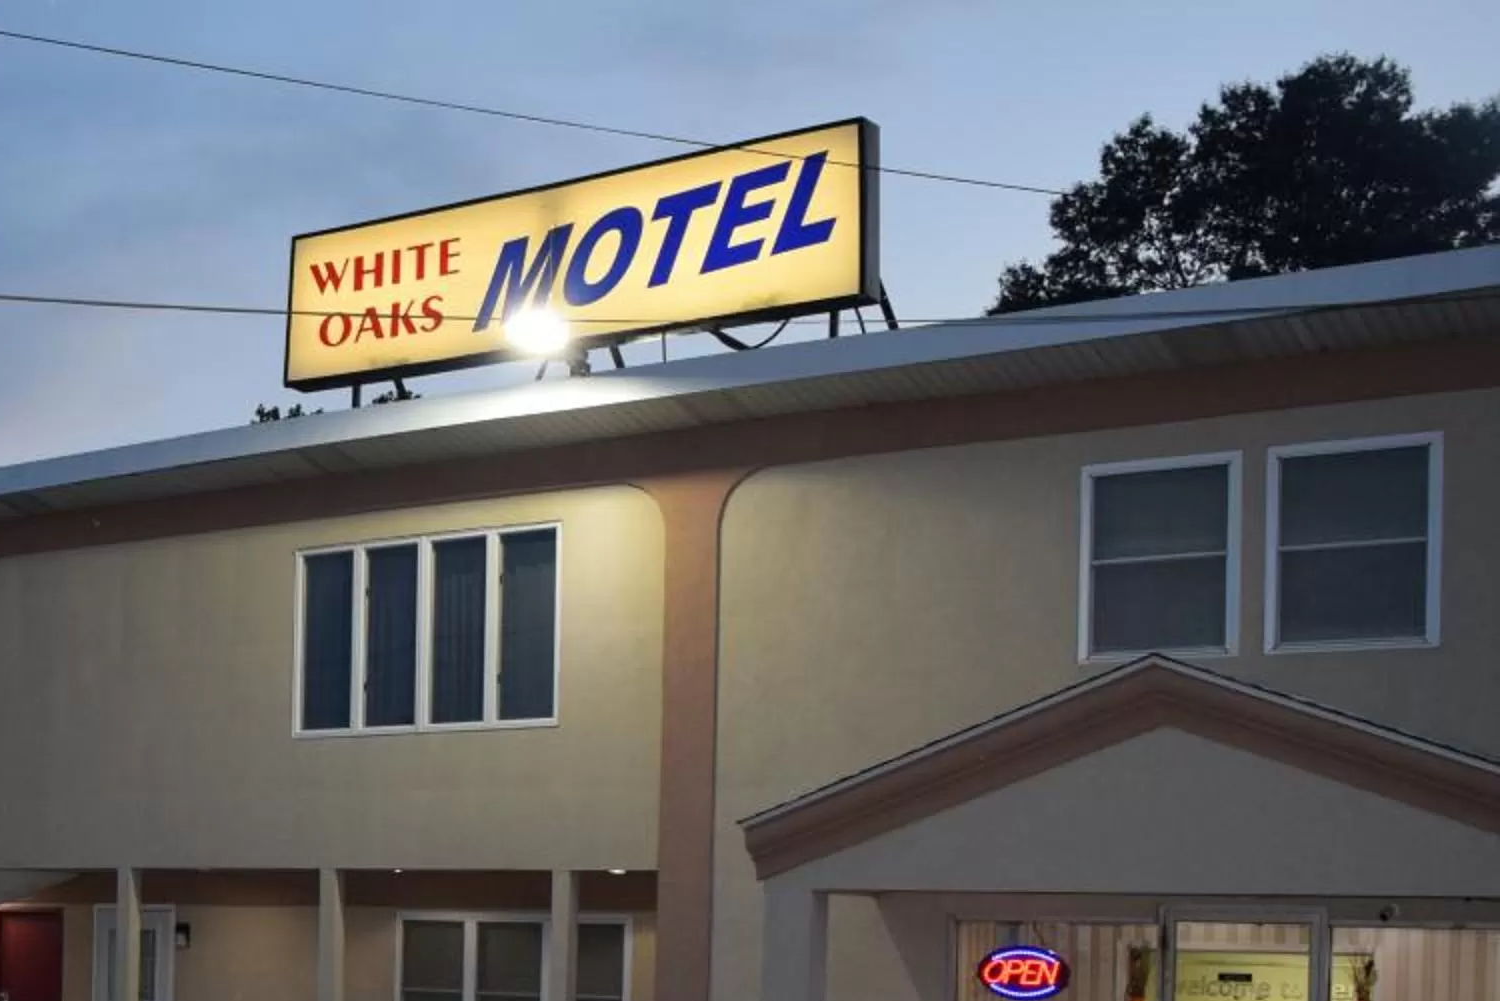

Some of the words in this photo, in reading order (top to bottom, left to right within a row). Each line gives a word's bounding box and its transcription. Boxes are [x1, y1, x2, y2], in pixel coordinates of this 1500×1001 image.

[309, 238, 460, 295] WHITE
[472, 150, 837, 332] MOTEL
[318, 296, 444, 347] OAKS
[984, 959, 1060, 985] OPEN
